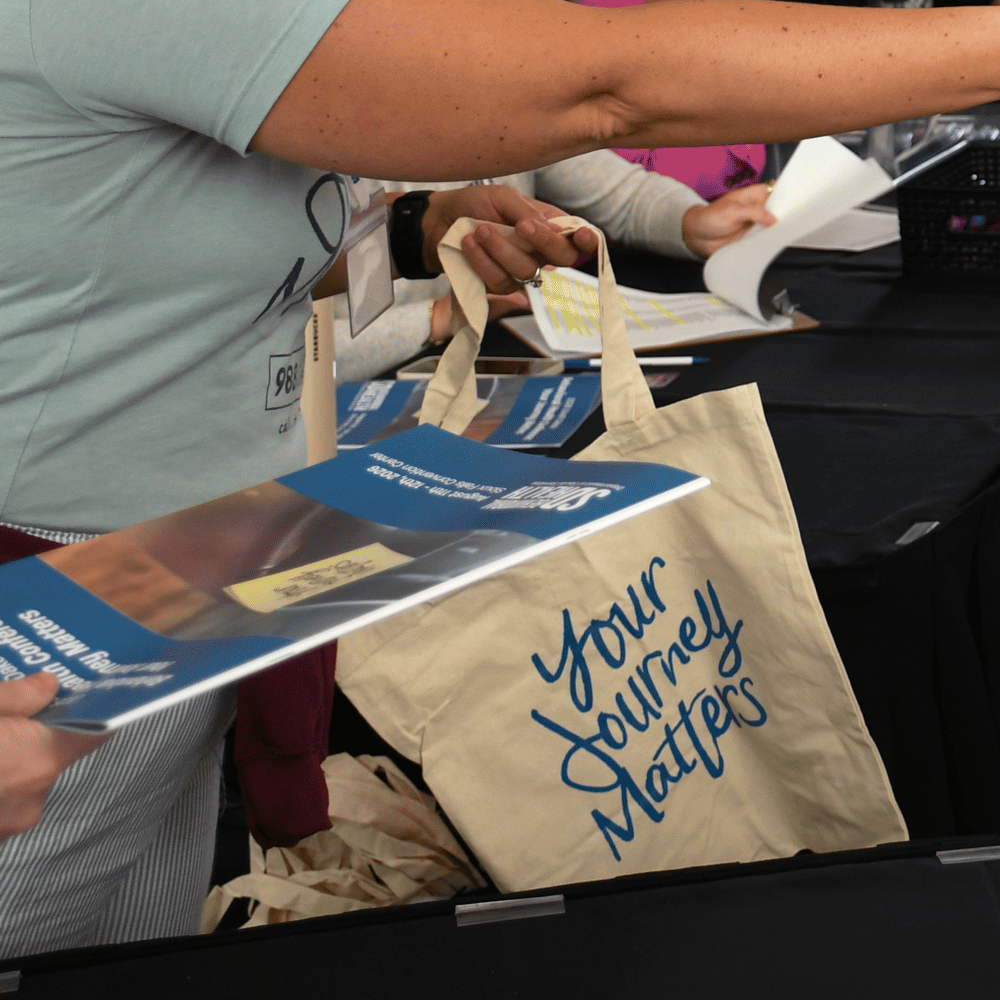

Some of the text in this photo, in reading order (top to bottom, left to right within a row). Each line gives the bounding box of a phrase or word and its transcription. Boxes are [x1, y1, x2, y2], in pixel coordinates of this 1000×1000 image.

[365, 465, 401, 480] 2026
[369, 451, 404, 468] Center
[401, 463, 457, 486] Convention
[17, 609, 91, 658] Matters
[531, 556, 666, 713] Your
[531, 579, 744, 793] Journey
[591, 677, 768, 862] Matters
